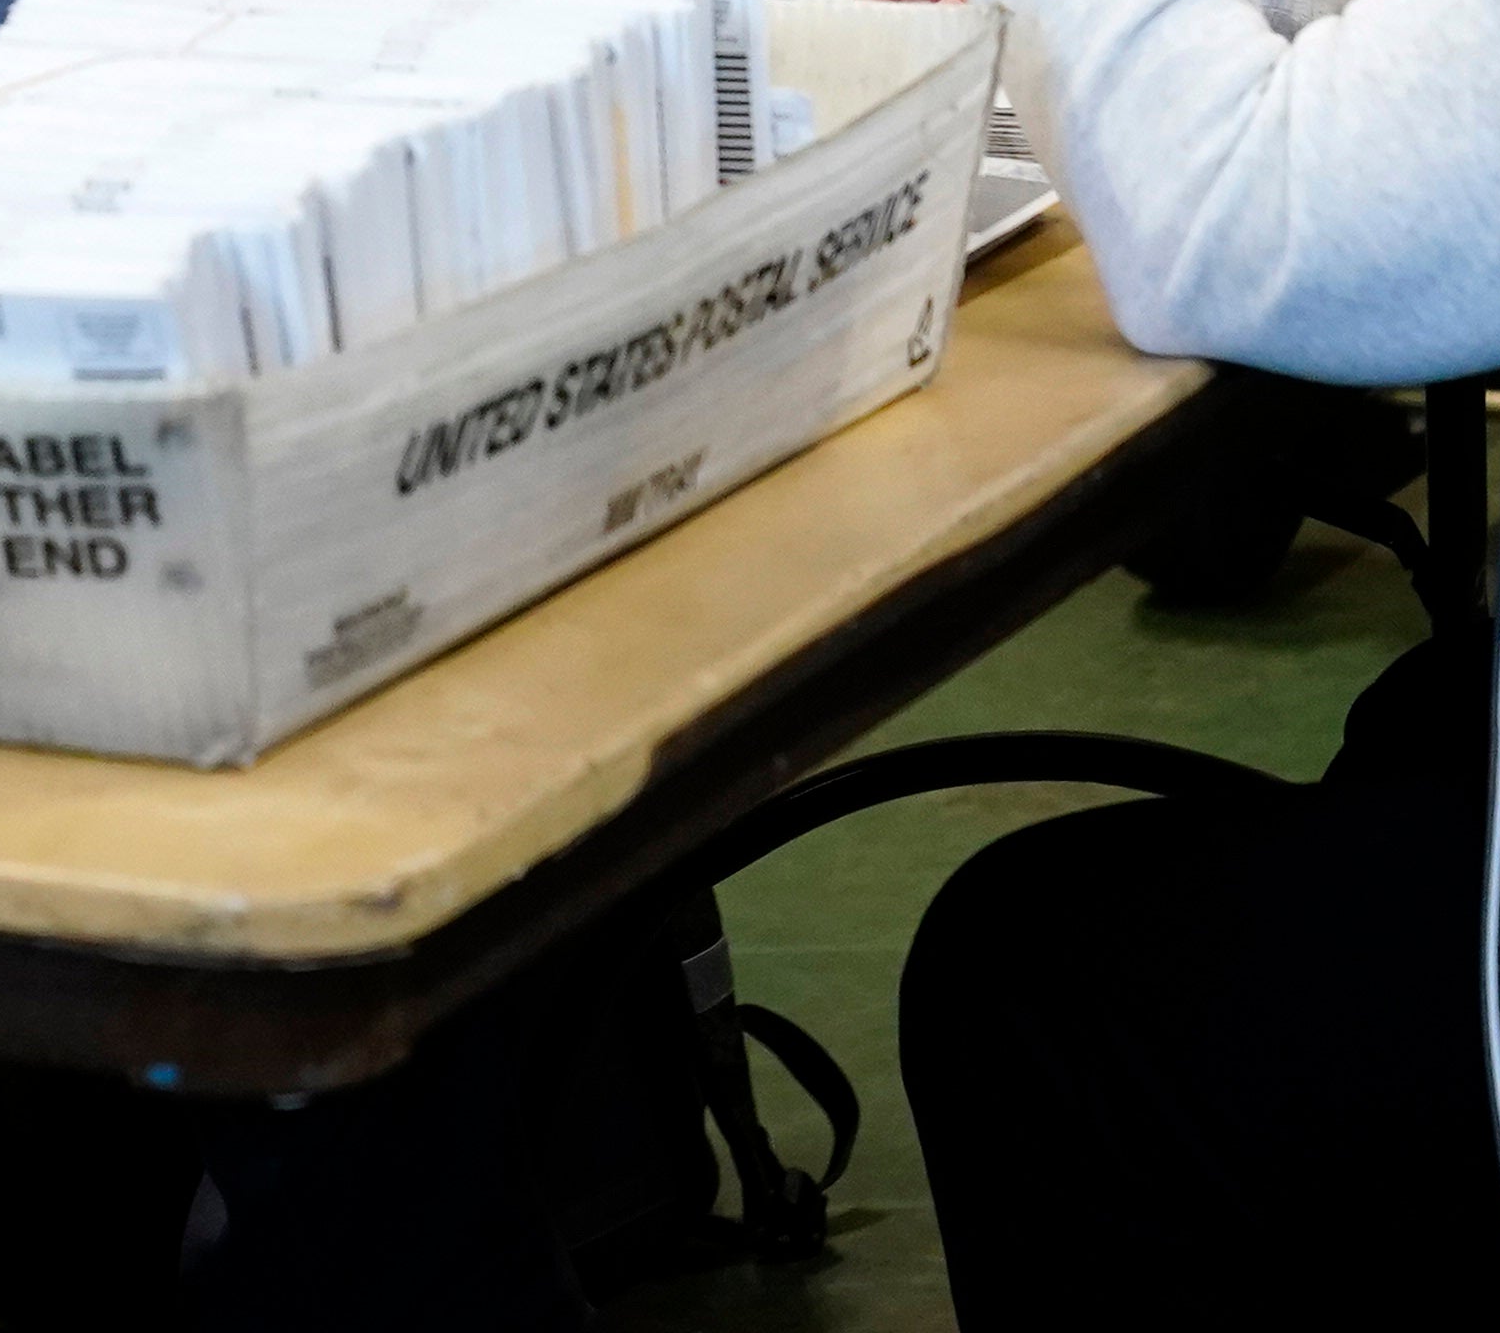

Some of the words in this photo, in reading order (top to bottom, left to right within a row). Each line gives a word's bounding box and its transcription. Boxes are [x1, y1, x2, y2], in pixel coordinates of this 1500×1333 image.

[395, 377, 543, 498] UNITED
[544, 312, 683, 431] STATES
[680, 247, 804, 359] POSTAL
[808, 169, 930, 293] SERVICE
[1, 535, 130, 581] END
